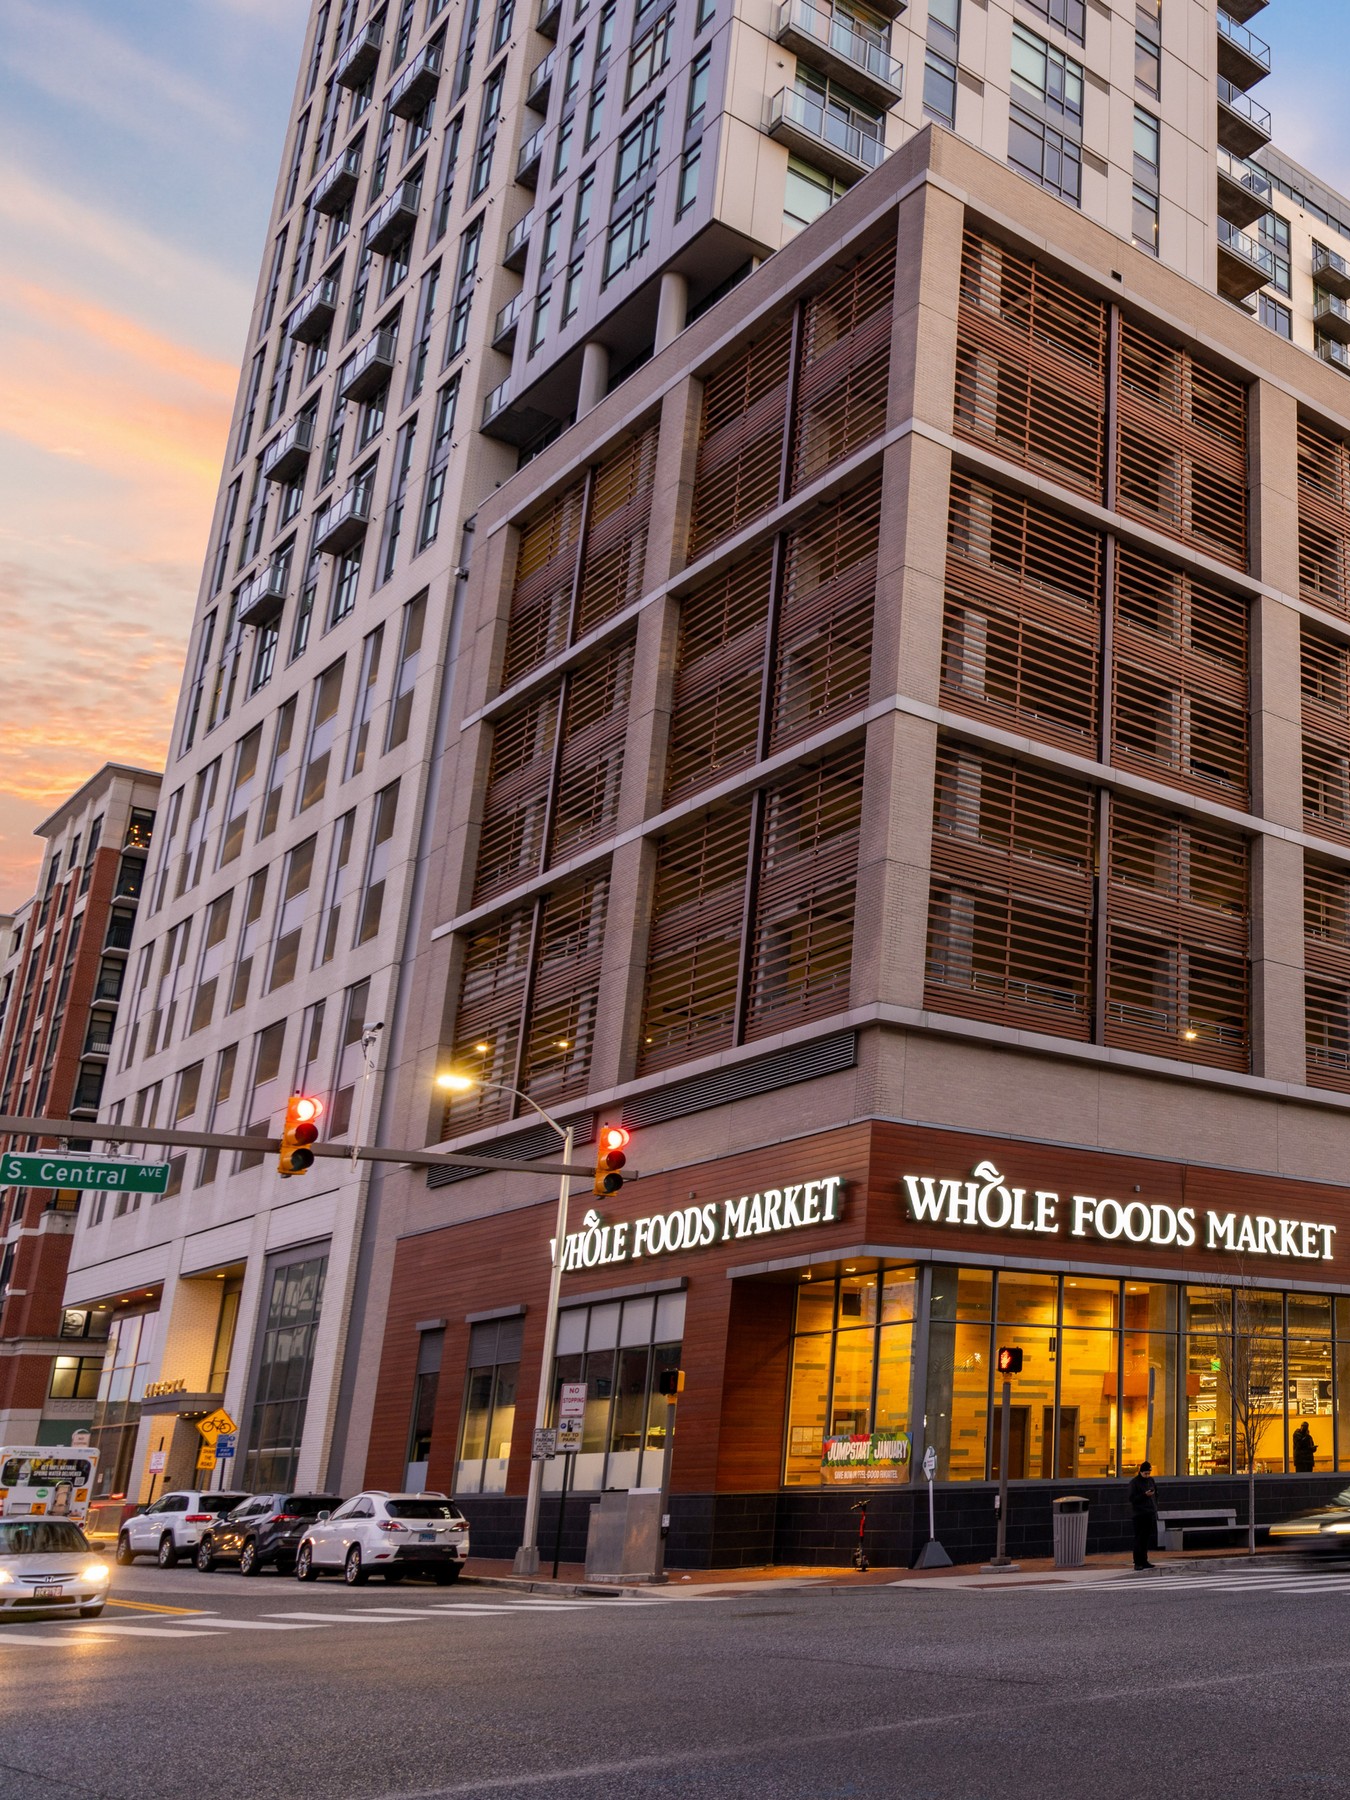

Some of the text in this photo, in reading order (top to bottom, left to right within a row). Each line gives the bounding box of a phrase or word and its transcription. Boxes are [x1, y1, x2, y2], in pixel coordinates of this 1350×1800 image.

[7, 1161, 163, 1185] S. Central AVE
[632, 1203, 717, 1258] FOODS
[722, 1176, 840, 1241] MARKET
[903, 1161, 1337, 1260] WHOLE FOODS MARKET
[828, 1440, 908, 1461] JUMPSTART JANUARY
